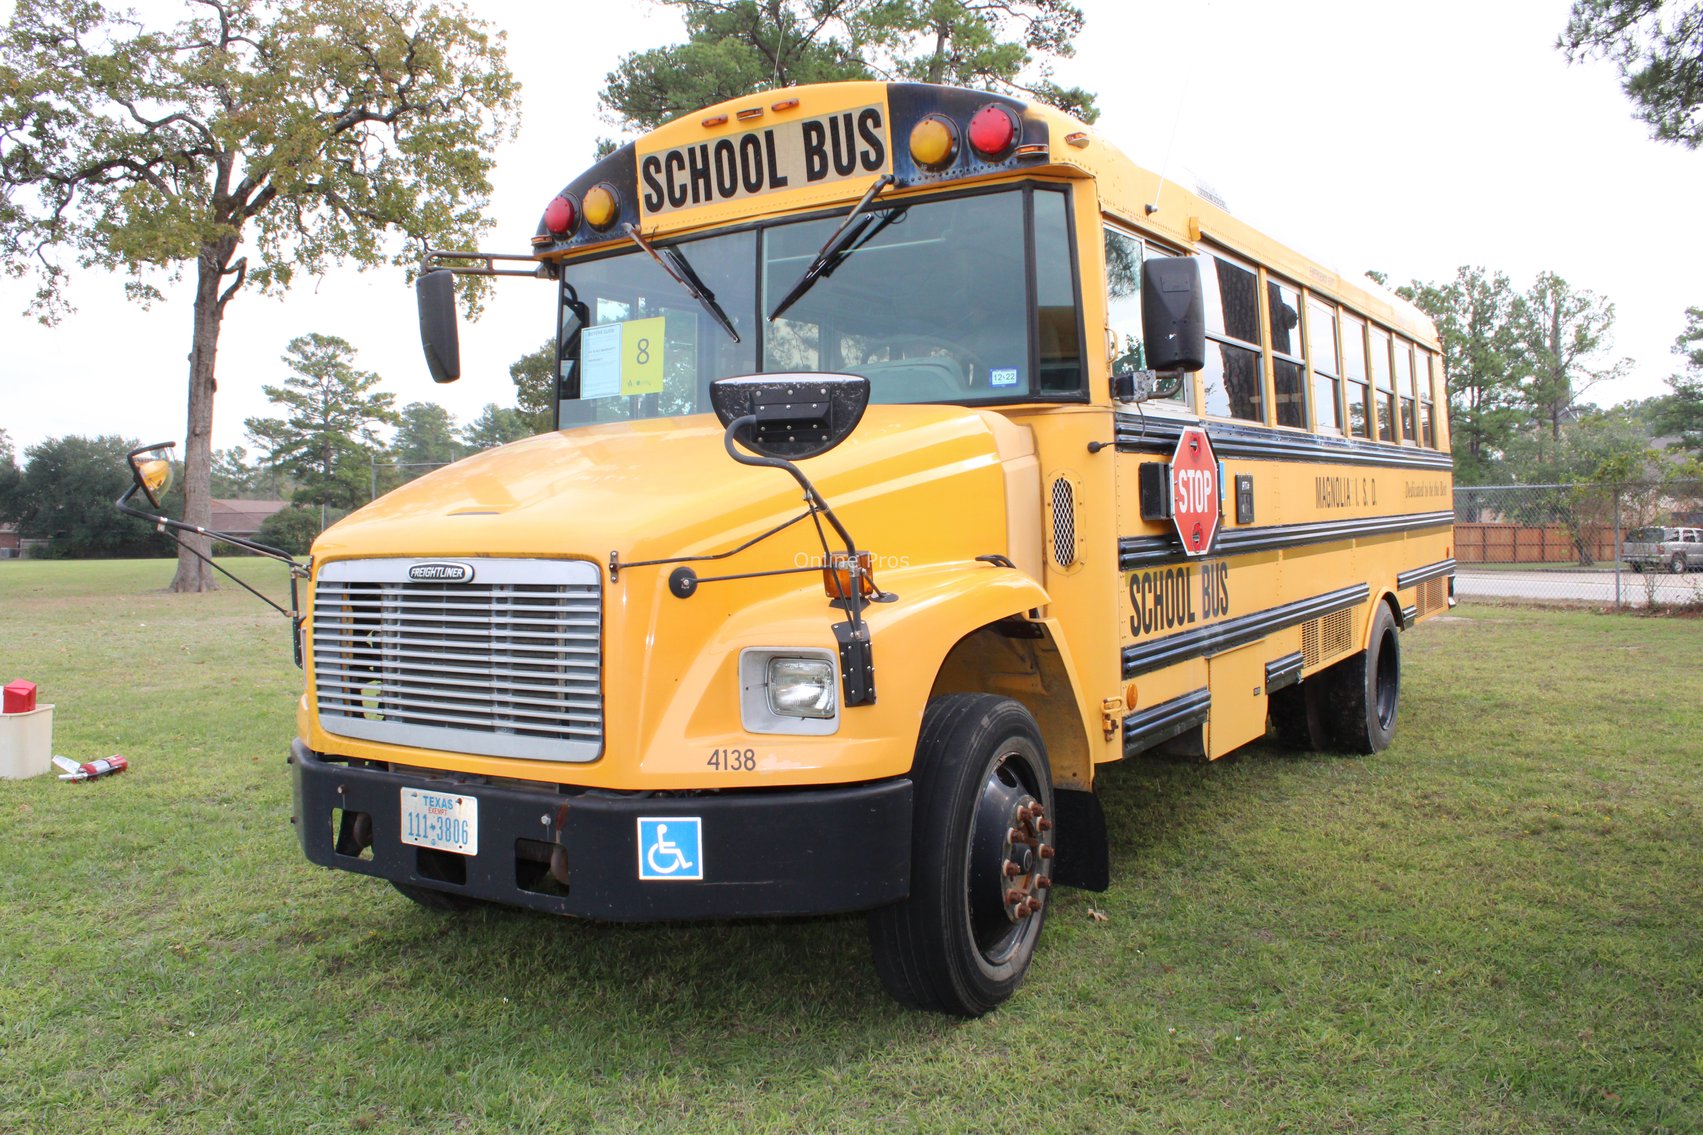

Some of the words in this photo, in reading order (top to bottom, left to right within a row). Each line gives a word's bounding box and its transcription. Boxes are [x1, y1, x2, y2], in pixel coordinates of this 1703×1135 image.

[642, 129, 788, 213] SCHOOL
[801, 107, 886, 183] BUS
[636, 338, 650, 365] 8
[1178, 468, 1212, 514] STOP
[1315, 476, 1351, 508] MAGNOLIA
[410, 566, 464, 578] FREIGHTLINER
[1129, 566, 1196, 637] SCHOOL
[1201, 561, 1229, 620] BUS
[706, 748, 756, 771] 4138
[422, 795, 454, 810] TEXAS
